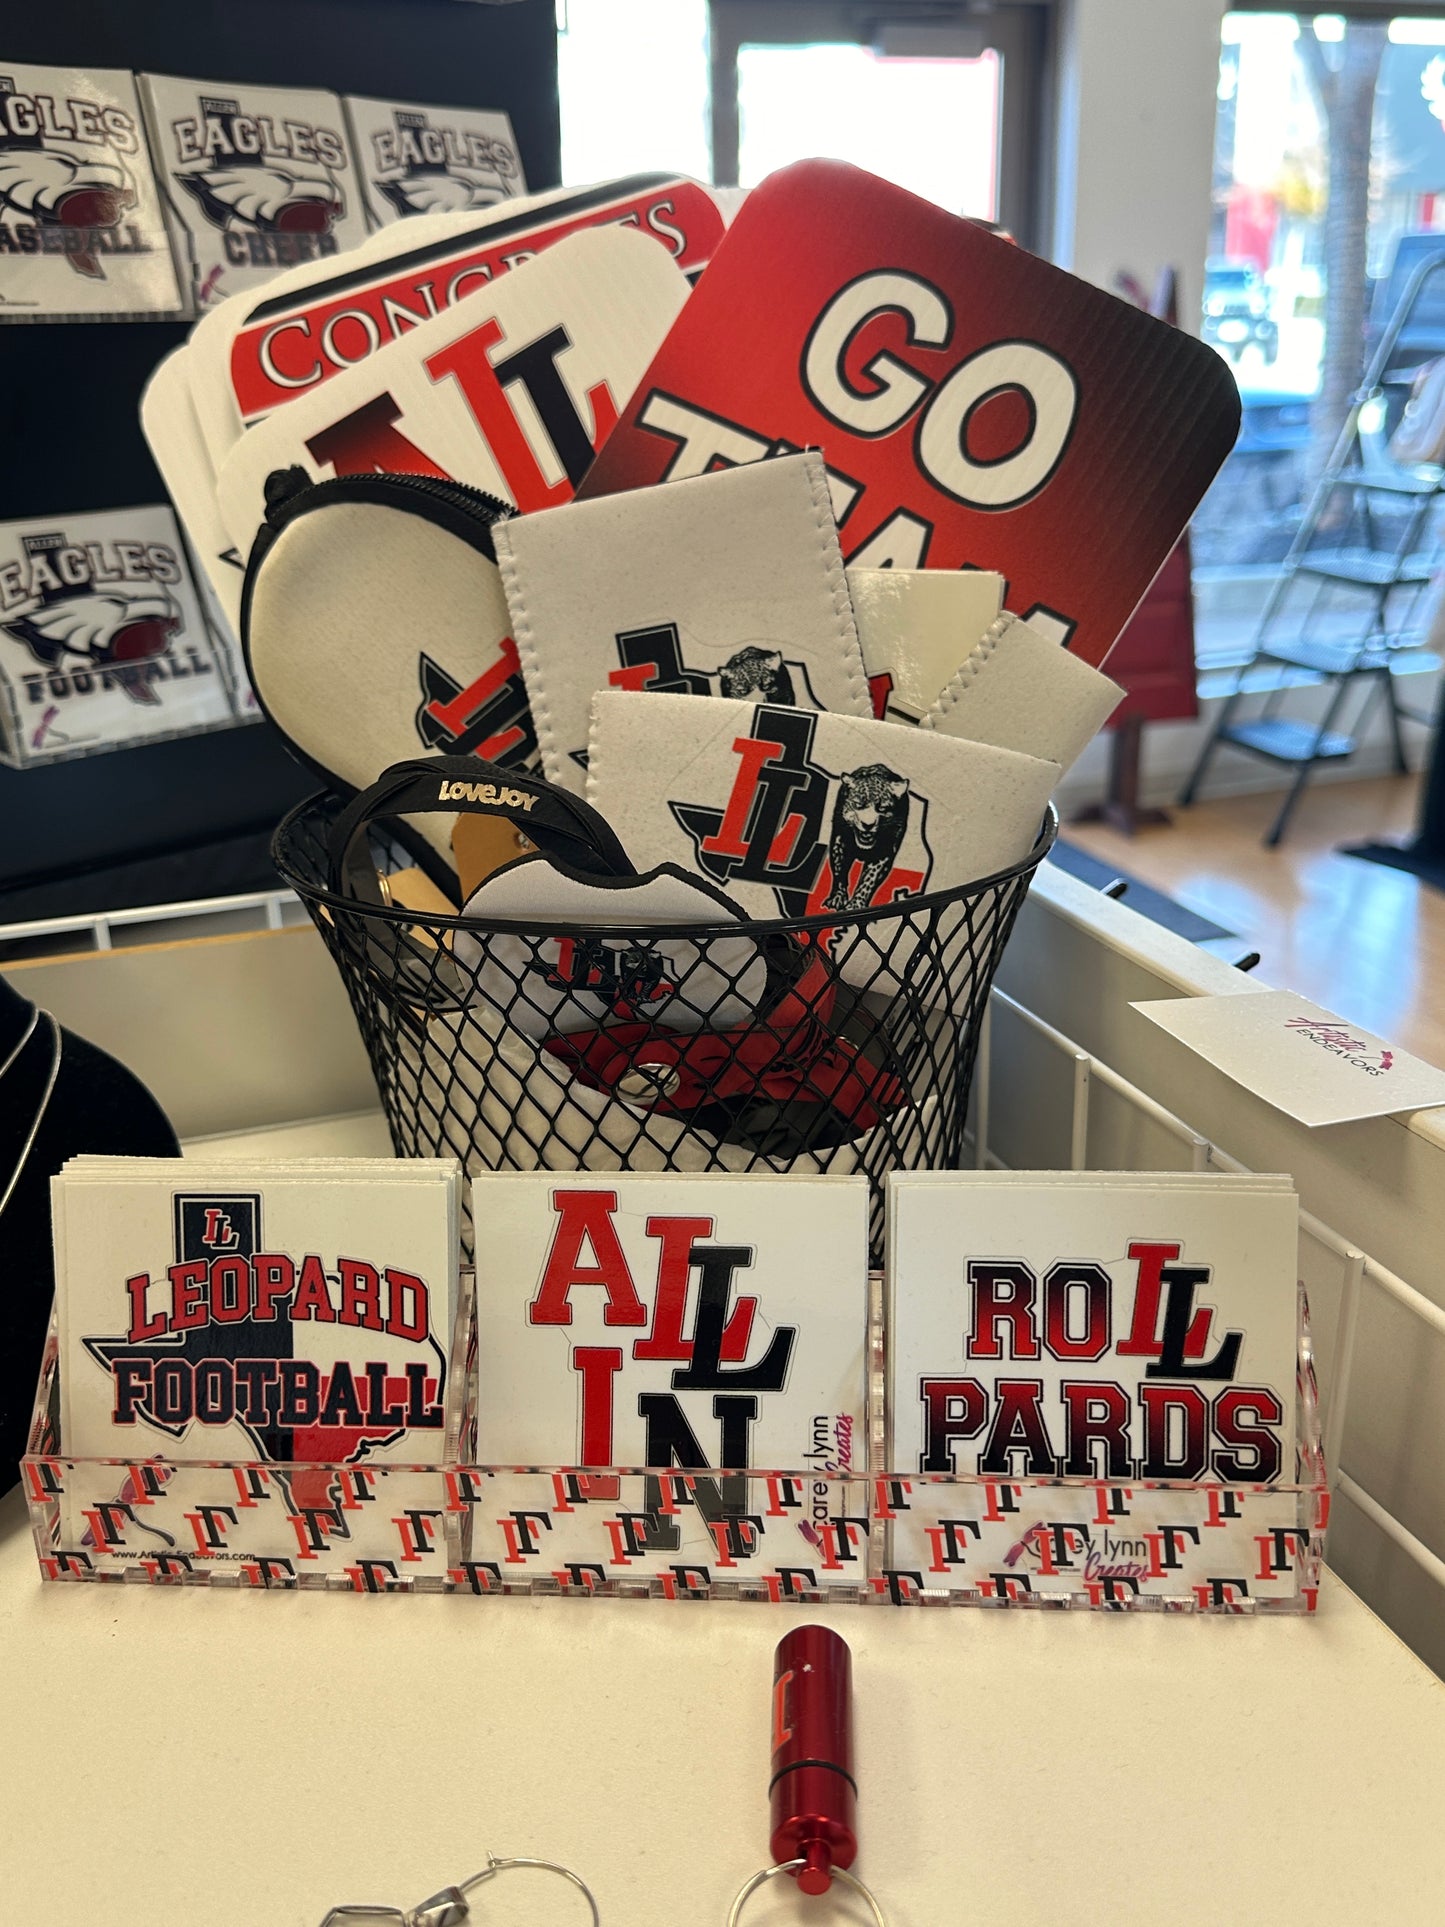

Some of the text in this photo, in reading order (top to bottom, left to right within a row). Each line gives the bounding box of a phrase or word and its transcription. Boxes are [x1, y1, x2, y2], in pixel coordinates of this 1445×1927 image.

[0, 93, 139, 155] GLES
[171, 109, 348, 170] EAGLES
[372, 126, 519, 179] EAGLES
[0, 224, 152, 255] ASEBALL
[800, 268, 1081, 513] GO
[0, 539, 182, 609] EAGLES
[1296, 1028, 1384, 1076] ENDEAVORS
[127, 1254, 430, 1344] LEOPARD
[966, 1242, 1244, 1382] ROLL
[111, 1357, 446, 1430] FOOTBALL
[919, 1376, 1283, 1486] PARDS
[1104, 1529, 1147, 1561] lynn
